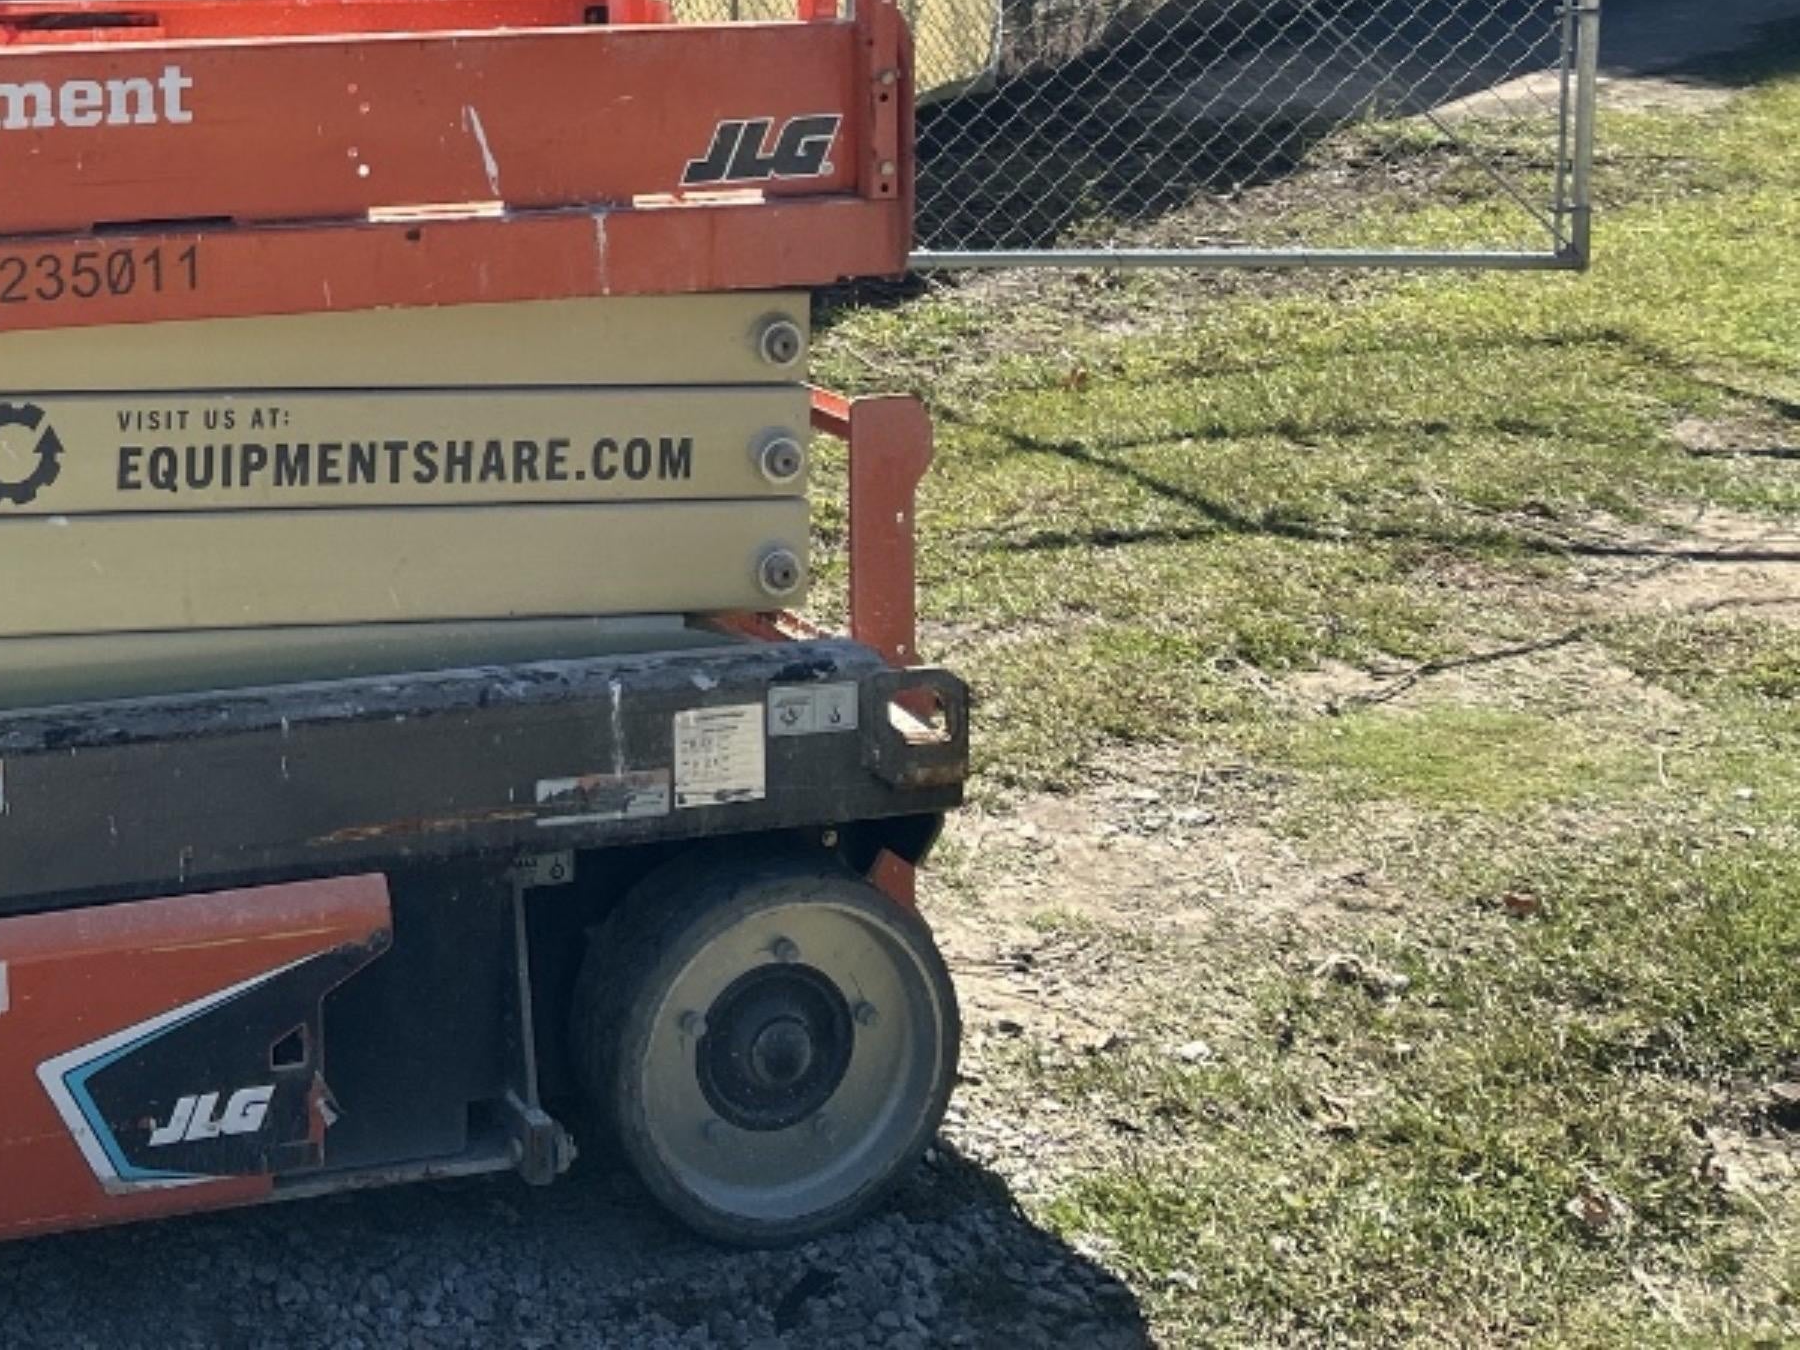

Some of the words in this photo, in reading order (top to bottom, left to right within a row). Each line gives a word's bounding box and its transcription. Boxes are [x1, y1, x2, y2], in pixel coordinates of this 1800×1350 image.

[678, 113, 845, 187] JLG
[117, 410, 191, 433] VISIT
[203, 409, 238, 430] US
[249, 407, 292, 430] AT:
[115, 436, 696, 493] EQUIPMENTSHARE.COM
[148, 1084, 277, 1147] JLG
